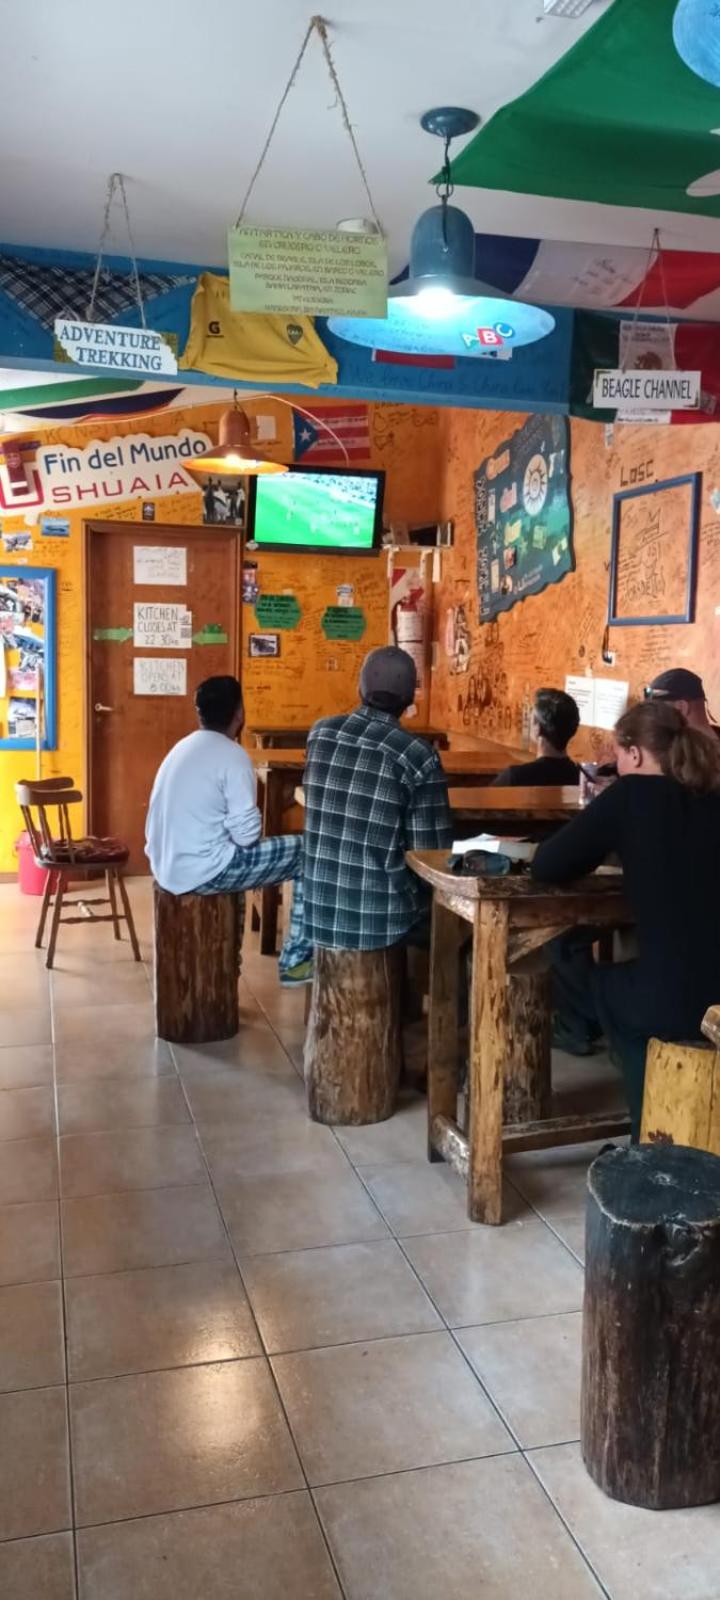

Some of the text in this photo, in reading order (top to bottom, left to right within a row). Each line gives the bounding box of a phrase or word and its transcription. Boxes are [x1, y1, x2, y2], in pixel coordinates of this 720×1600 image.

[59, 325, 161, 351] ADVENTURE
[75, 347, 163, 371] TREKKING
[601, 378, 692, 400] BEAGLE CHANNEL
[44, 437, 207, 475] Fin del Mundo
[137, 606, 179, 621] KITCHEN
[167, 621, 178, 633] AT
